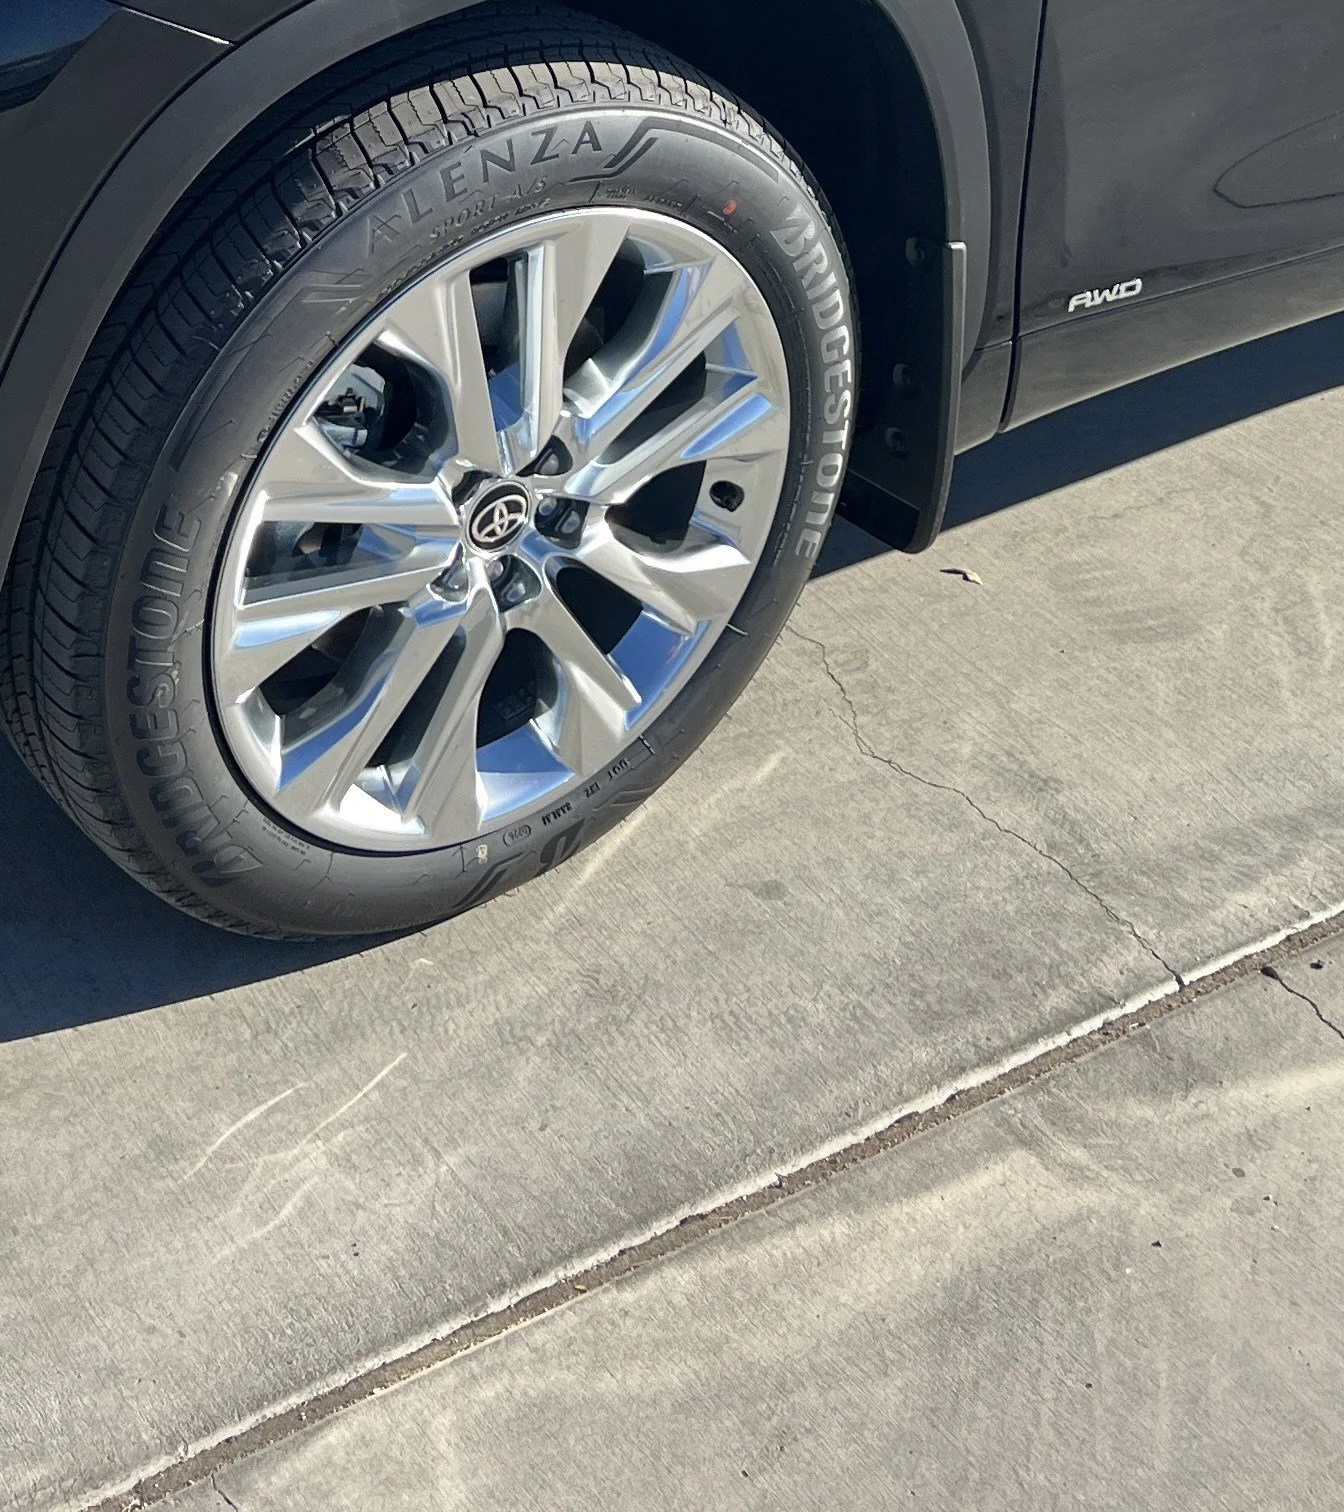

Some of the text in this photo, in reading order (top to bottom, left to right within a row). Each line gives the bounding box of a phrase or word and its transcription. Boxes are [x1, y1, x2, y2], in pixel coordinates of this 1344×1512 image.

[365, 120, 603, 256] ALENZA
[430, 191, 500, 240] SPORT
[1067, 278, 1143, 313] AWD
[770, 202, 853, 558] BRIDGESTONE
[125, 501, 263, 886] BRIDGESTONE
